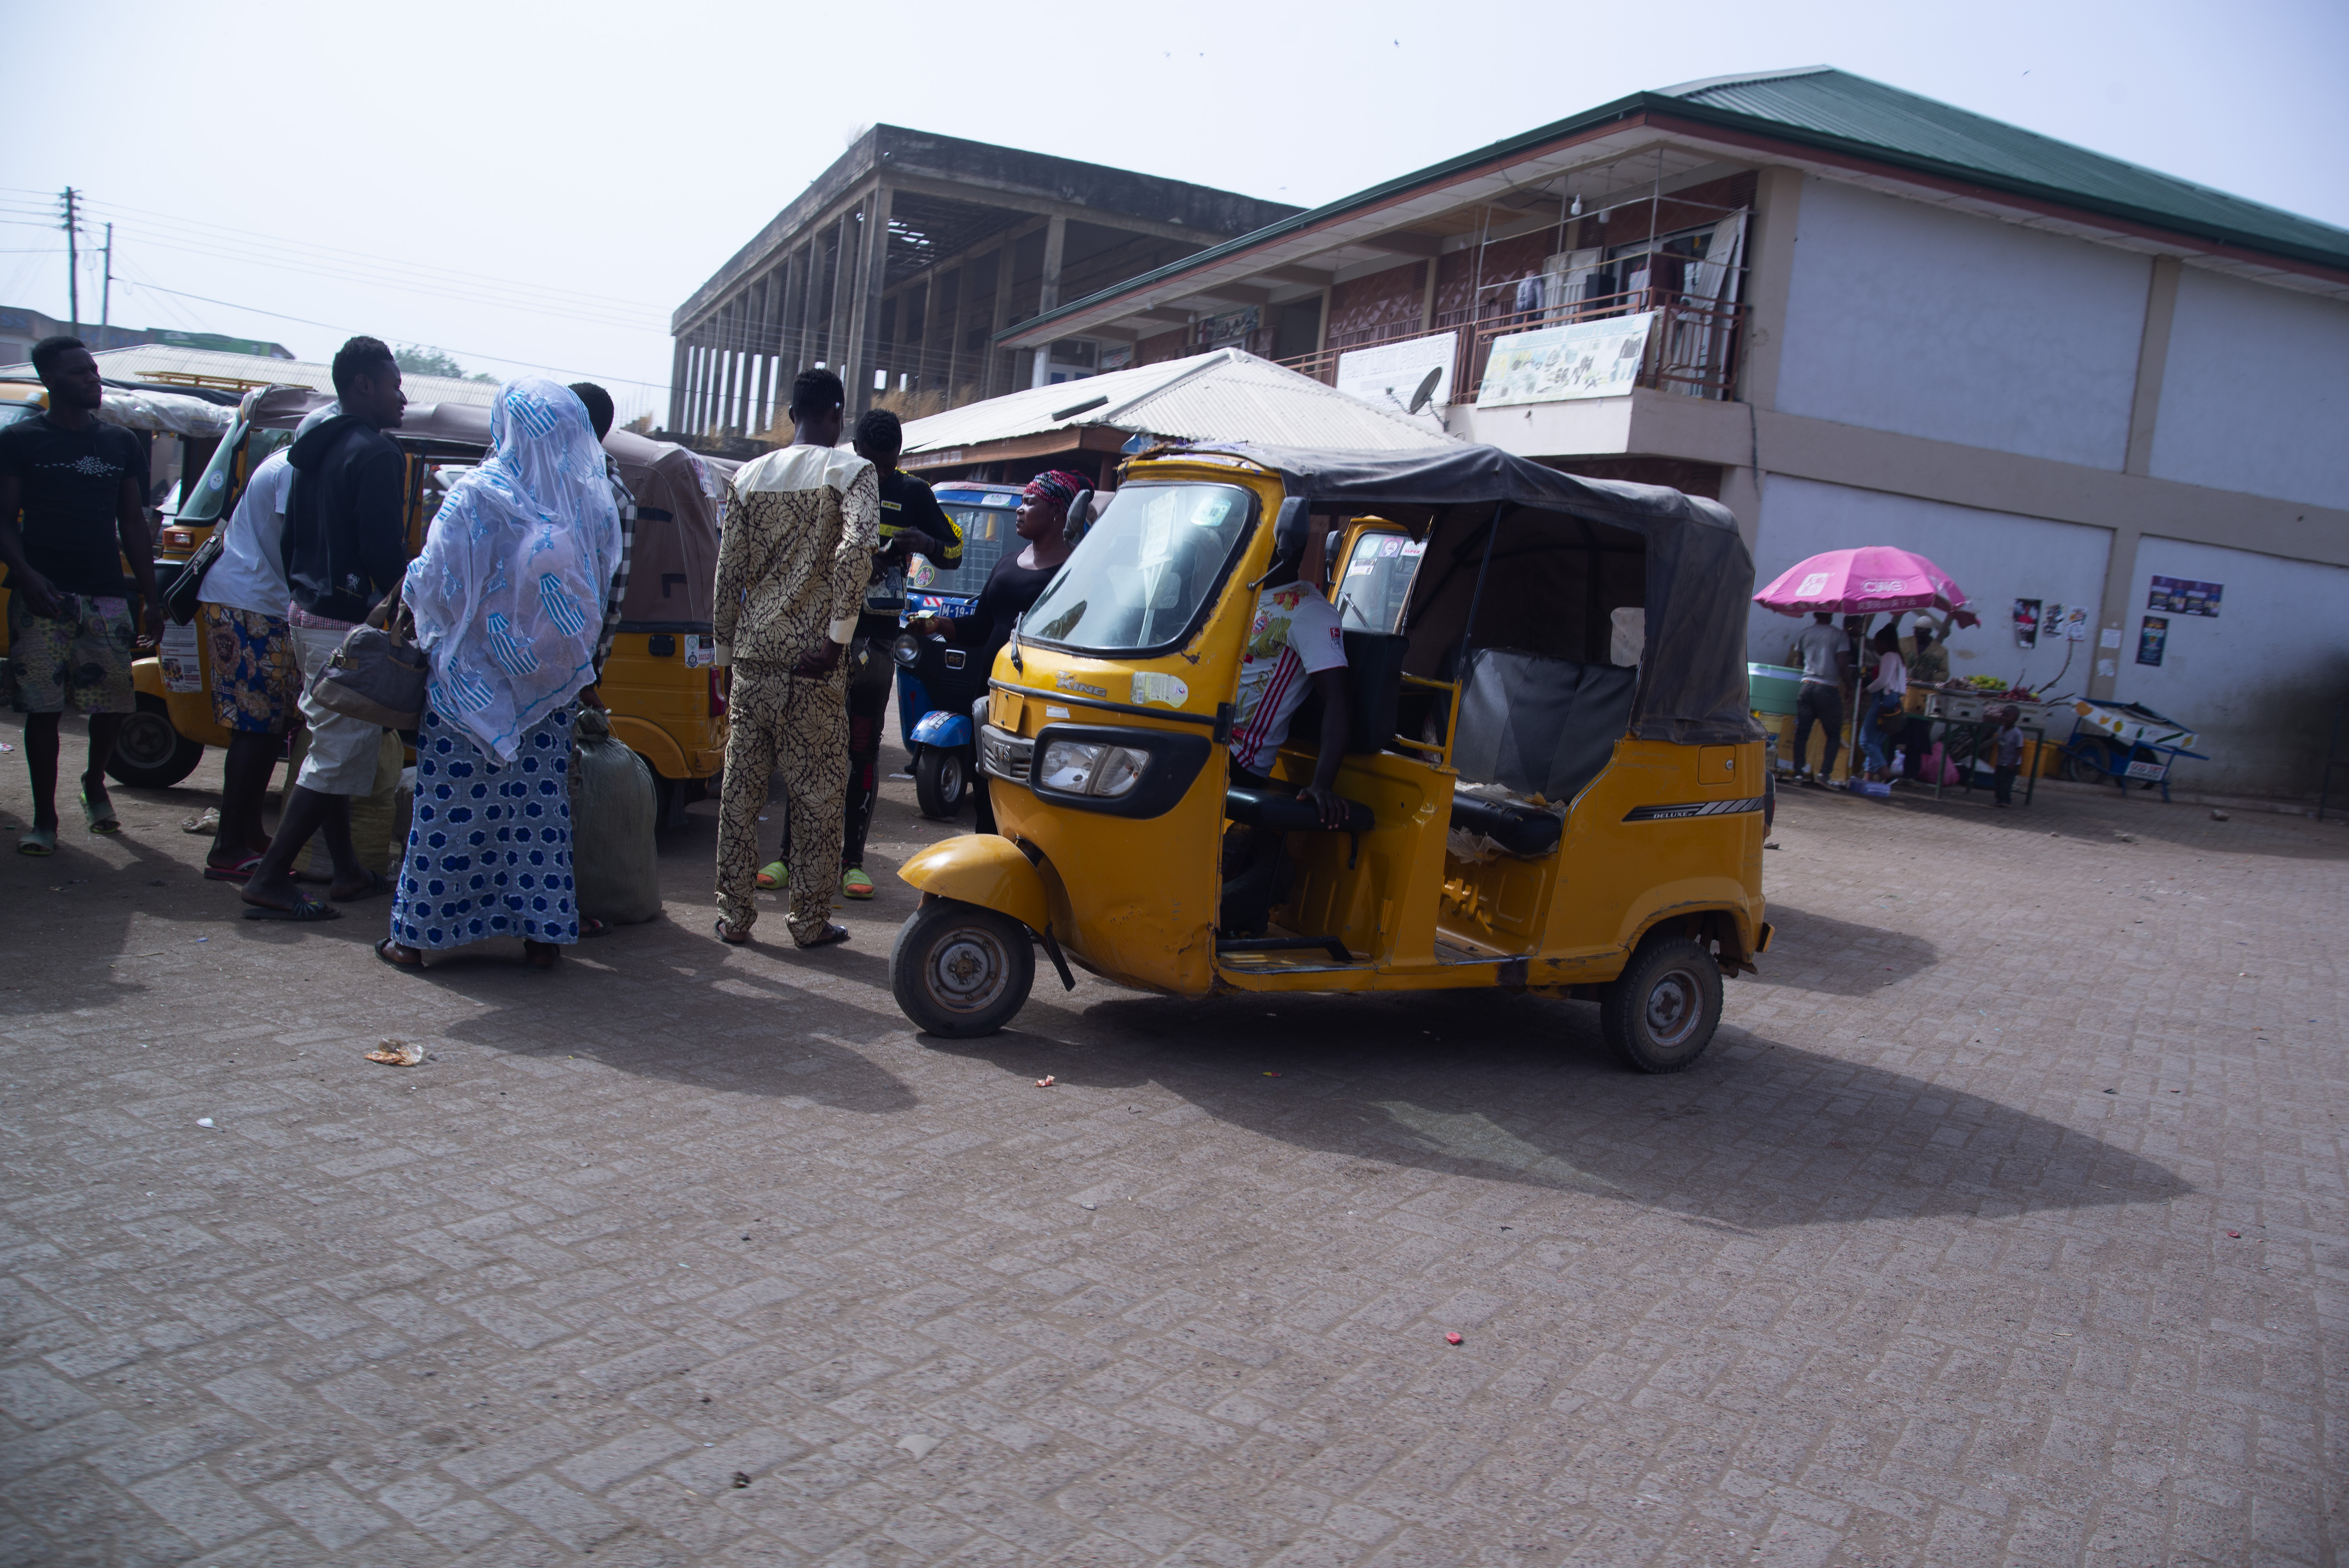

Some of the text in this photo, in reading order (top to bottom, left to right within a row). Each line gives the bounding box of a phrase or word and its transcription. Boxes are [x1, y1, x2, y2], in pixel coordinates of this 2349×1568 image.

[1399, 337, 1451, 370] PHONES
[1056, 679, 1107, 697] KING
[993, 741, 1011, 762] TVS
[1653, 811, 1689, 819] DELUXE
